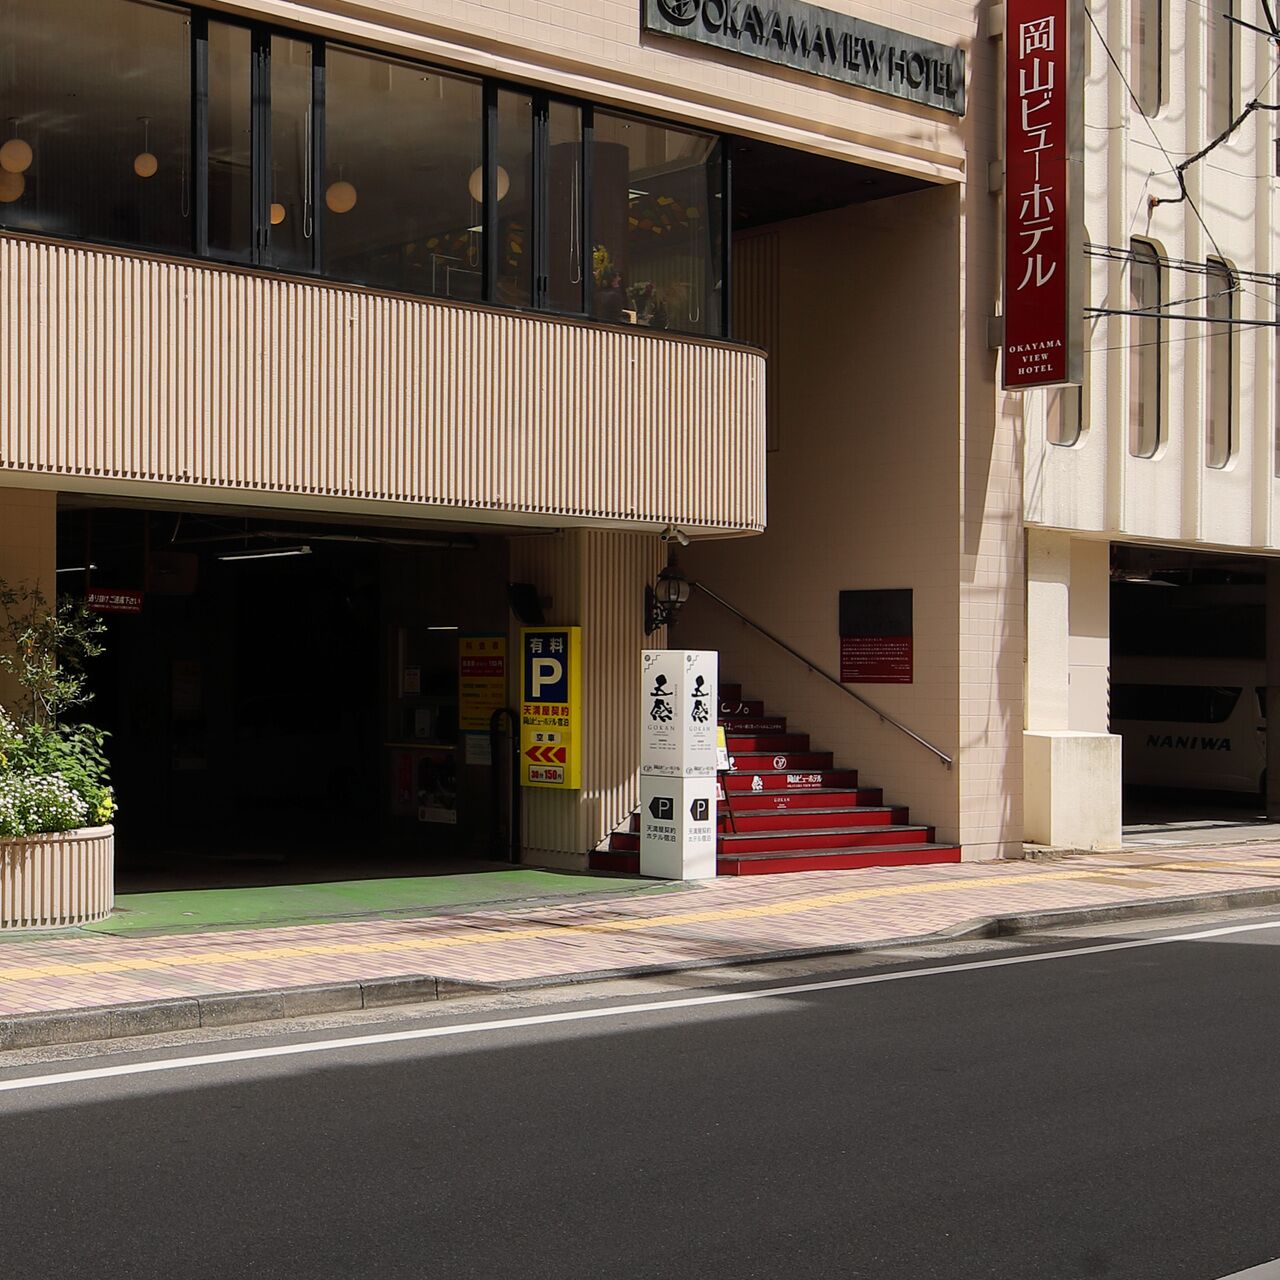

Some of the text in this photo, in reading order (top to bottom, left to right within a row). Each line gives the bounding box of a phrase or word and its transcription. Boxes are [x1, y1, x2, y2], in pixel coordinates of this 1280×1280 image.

[823, 26, 887, 77] VIEW
[888, 45, 958, 99] HOTEL
[1016, 15, 1057, 291] 岡山ビューホテル
[1009, 339, 1062, 353] OKAYAMA
[1022, 353, 1049, 363] VIEW
[1018, 364, 1053, 375] HOTEL
[529, 637, 564, 654] 有料
[531, 657, 563, 698] P
[523, 705, 569, 717] 天満屋契約
[648, 724, 675, 732] GOKAN
[1146, 734, 1233, 751] NANIWA
[658, 799, 670, 818] P
[696, 800, 706, 819] P
